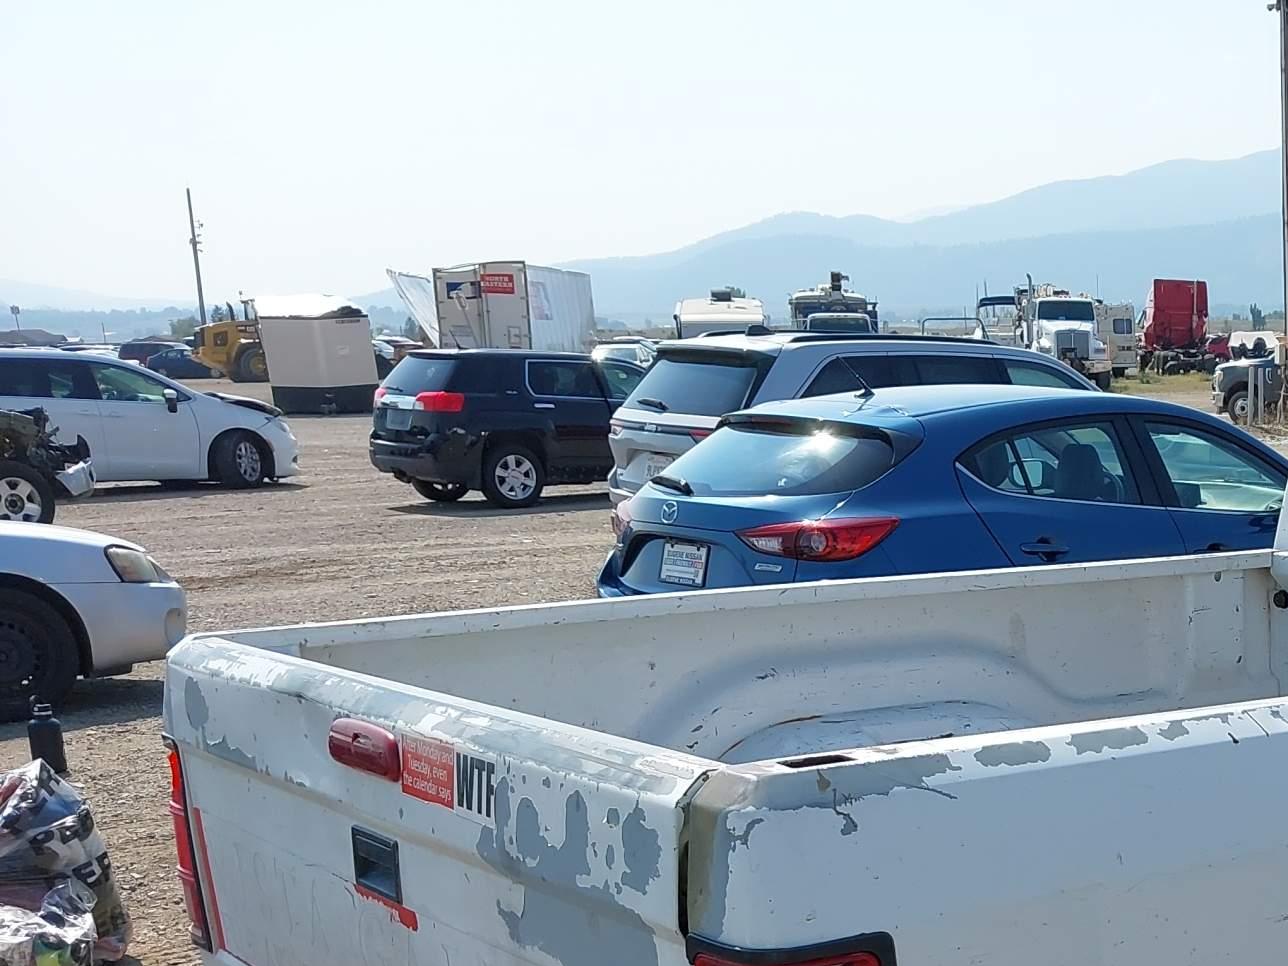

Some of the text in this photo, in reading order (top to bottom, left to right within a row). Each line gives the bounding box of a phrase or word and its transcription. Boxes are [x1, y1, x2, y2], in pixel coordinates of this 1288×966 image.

[408, 754, 448, 782] Tuesday, even
[417, 741, 440, 764] Monday
[440, 751, 454, 766] and
[403, 770, 452, 803] the calendar says
[455, 752, 495, 818] WTF
